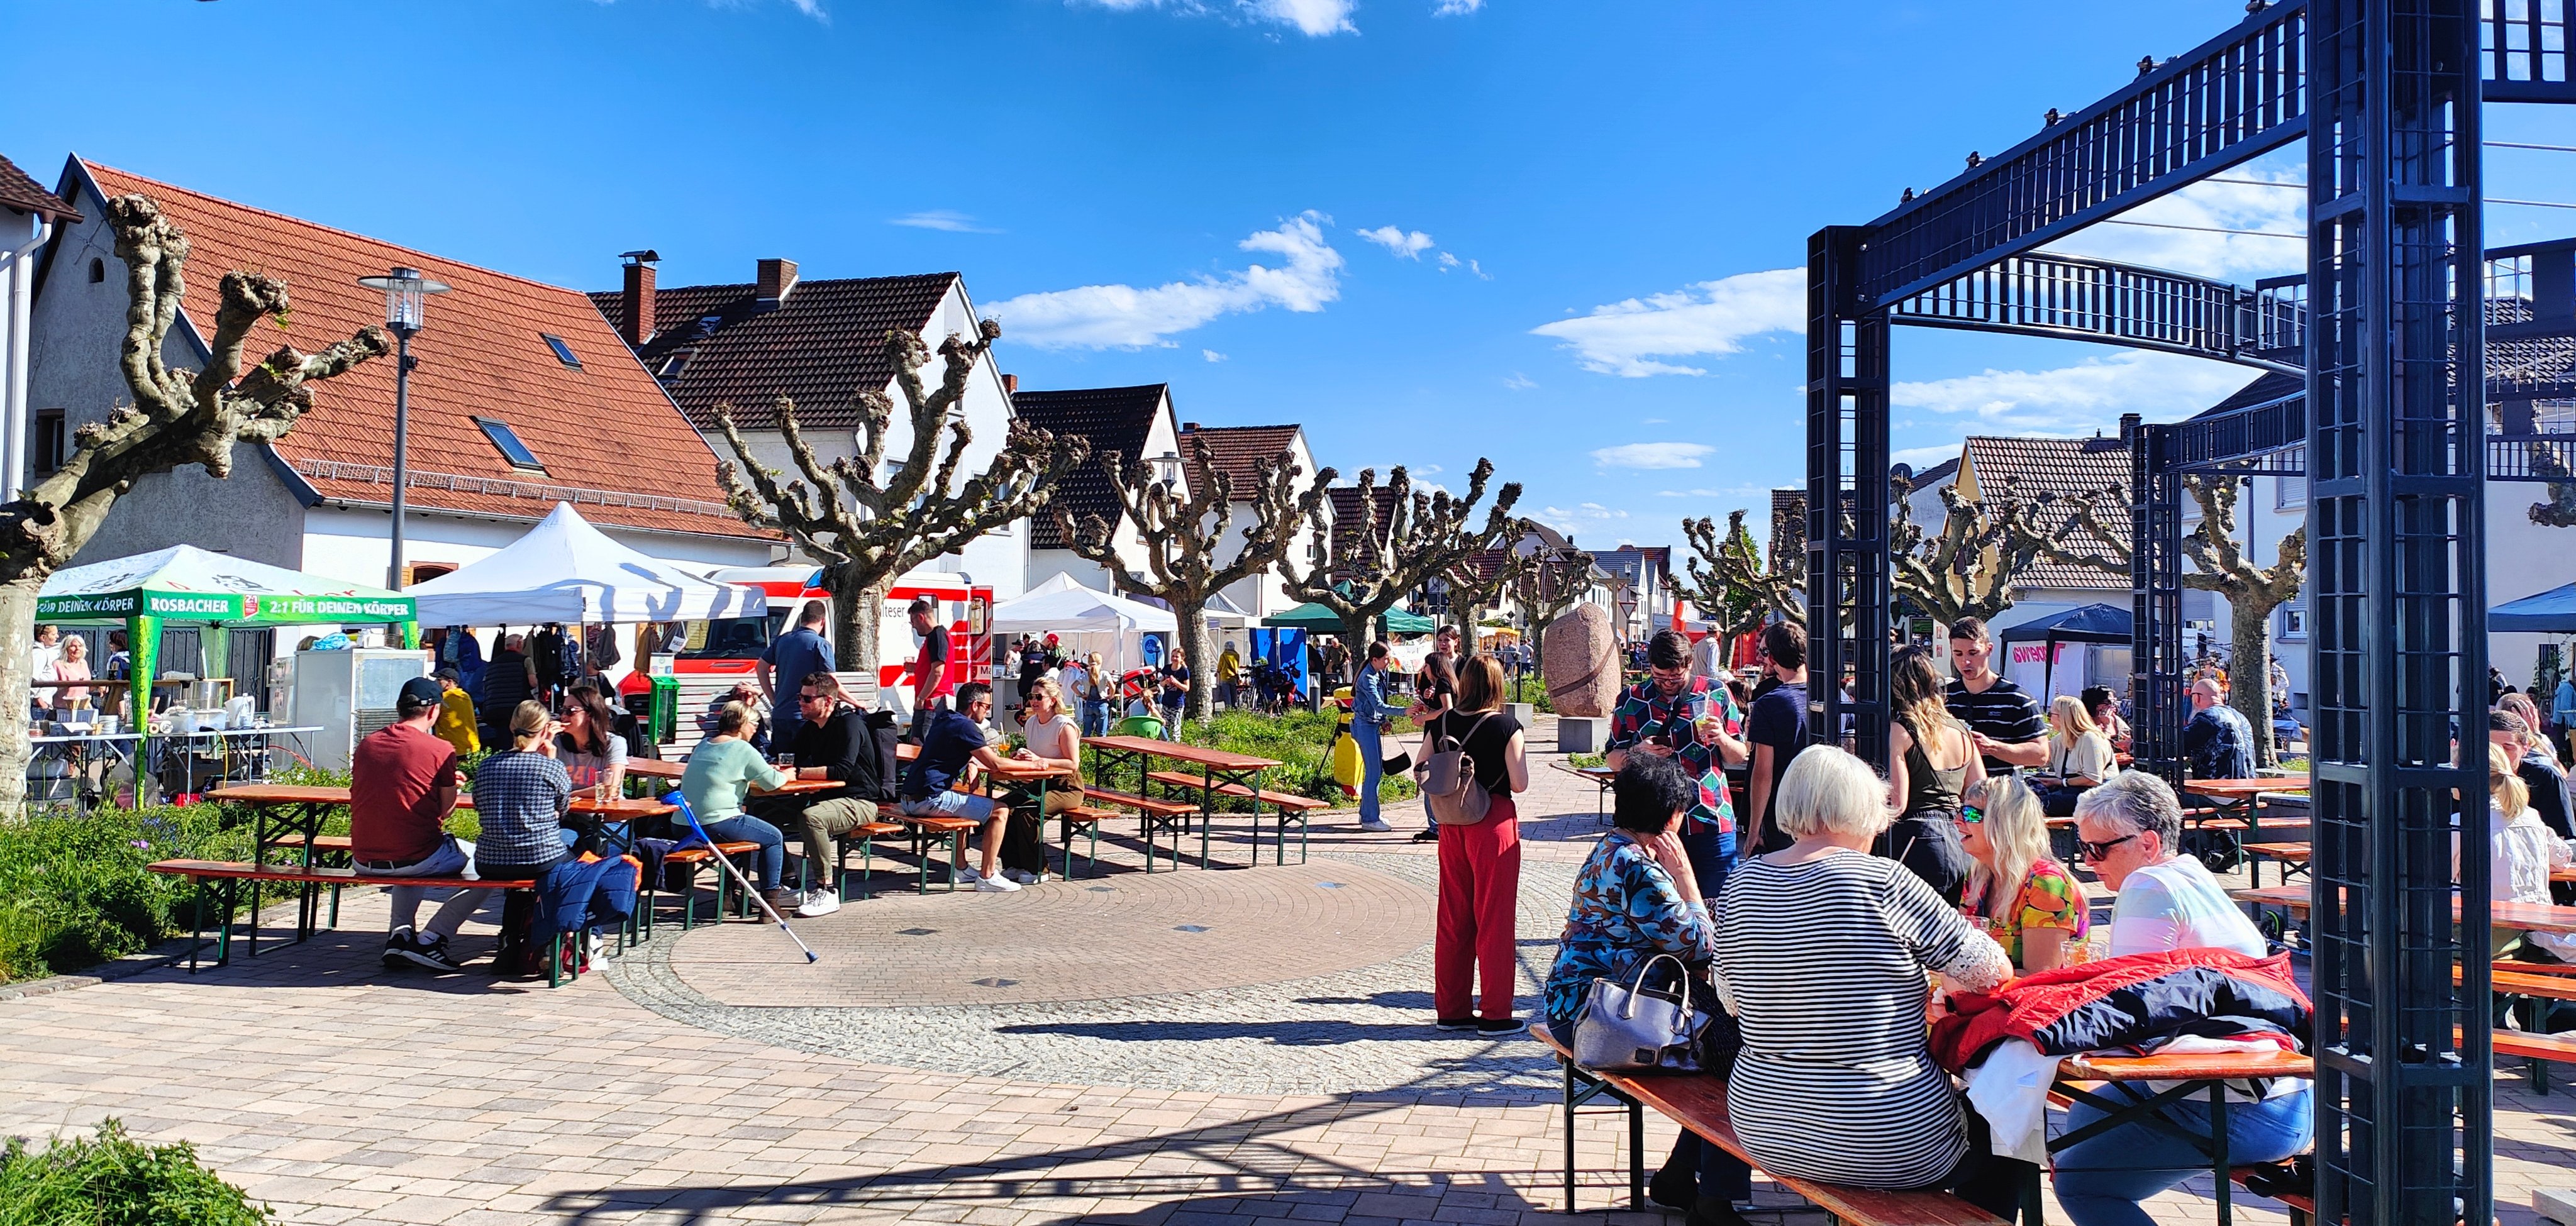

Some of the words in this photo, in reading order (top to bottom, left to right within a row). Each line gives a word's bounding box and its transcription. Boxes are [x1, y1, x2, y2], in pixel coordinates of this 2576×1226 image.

[57, 599, 94, 613] DEINEN
[94, 597, 134, 612] KÖRPER
[151, 597, 229, 613] ROSBACHER
[270, 601, 288, 614] 2:1
[292, 599, 315, 614] FÜR
[318, 601, 362, 614] DEINEN
[364, 600, 409, 616] KÖRPER
[880, 602, 906, 617] lteser
